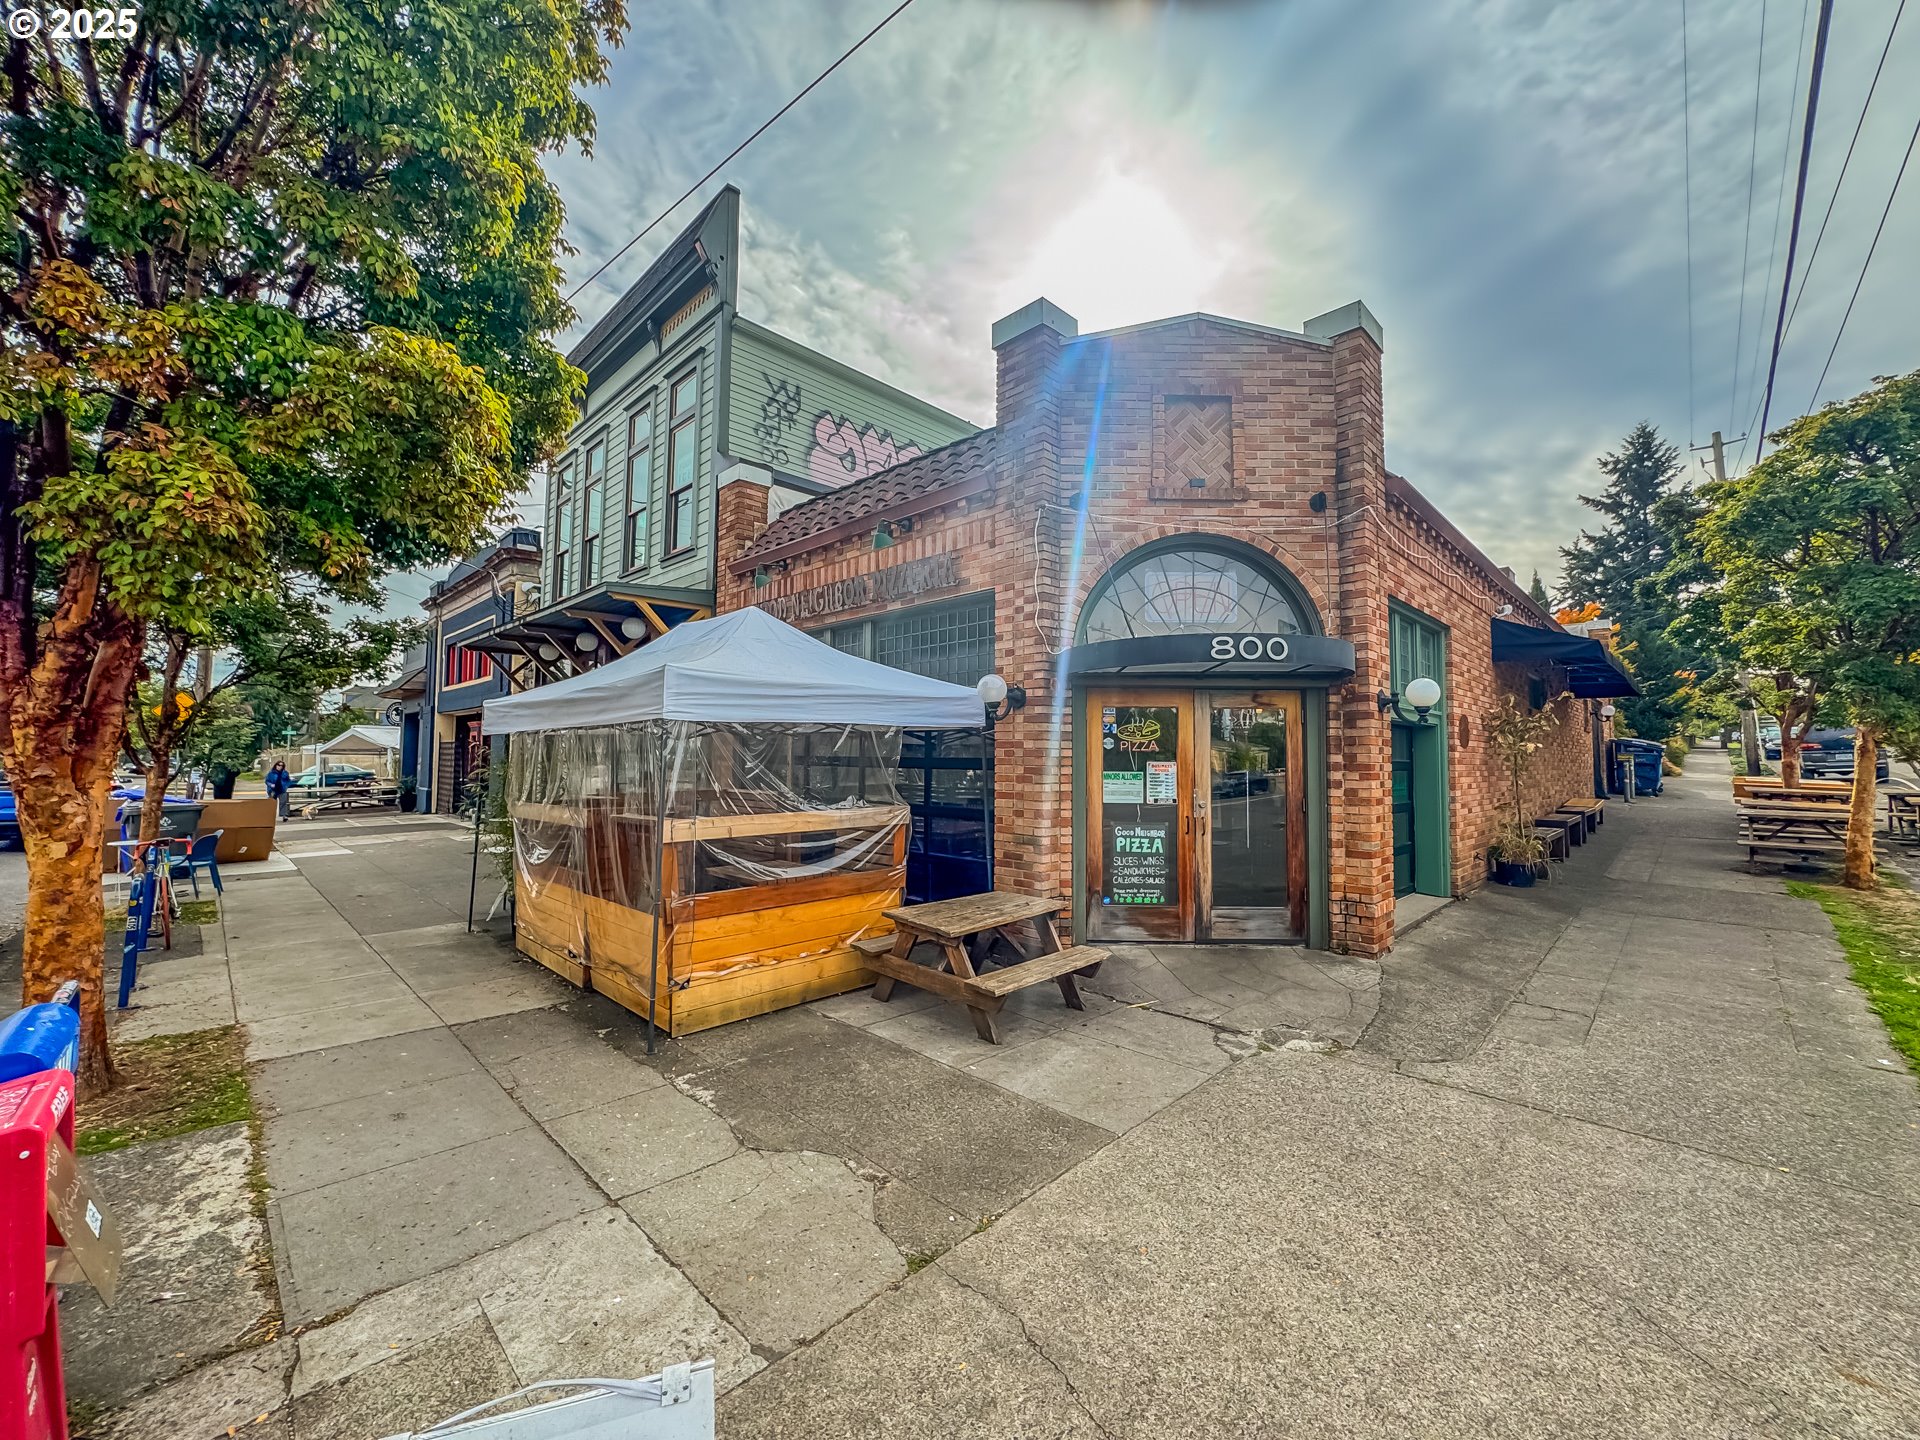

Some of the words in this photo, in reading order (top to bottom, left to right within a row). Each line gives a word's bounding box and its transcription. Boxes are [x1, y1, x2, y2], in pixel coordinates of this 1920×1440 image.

[787, 578, 868, 621] NEIGHBOR
[1152, 581, 1230, 614] OPEN
[1210, 636, 1289, 660] 800
[1120, 740, 1159, 752] PIZZA
[1116, 837, 1164, 854] PIZZA
